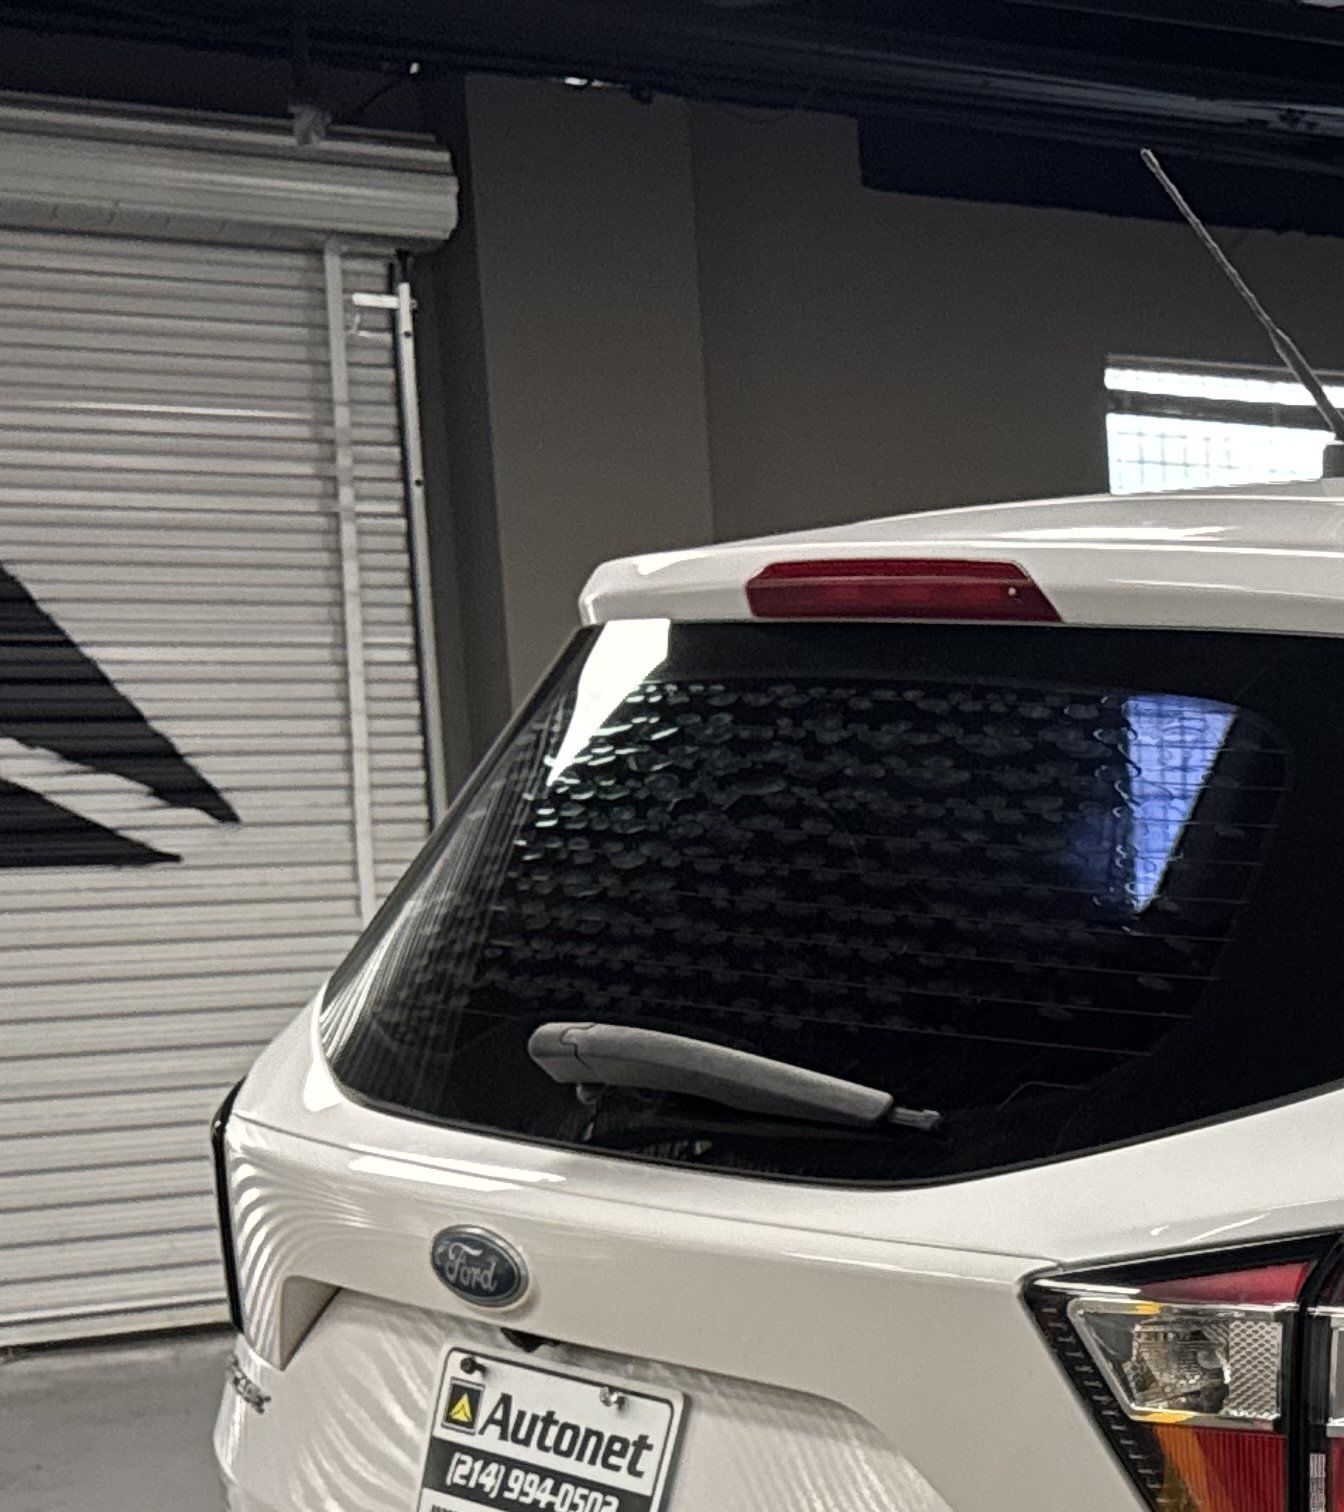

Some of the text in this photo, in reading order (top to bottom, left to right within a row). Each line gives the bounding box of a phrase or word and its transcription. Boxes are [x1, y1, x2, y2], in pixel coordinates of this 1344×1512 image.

[447, 1241, 498, 1292] Ford
[479, 1393, 654, 1478] Autonet
[447, 1452, 503, 1498] (214)
